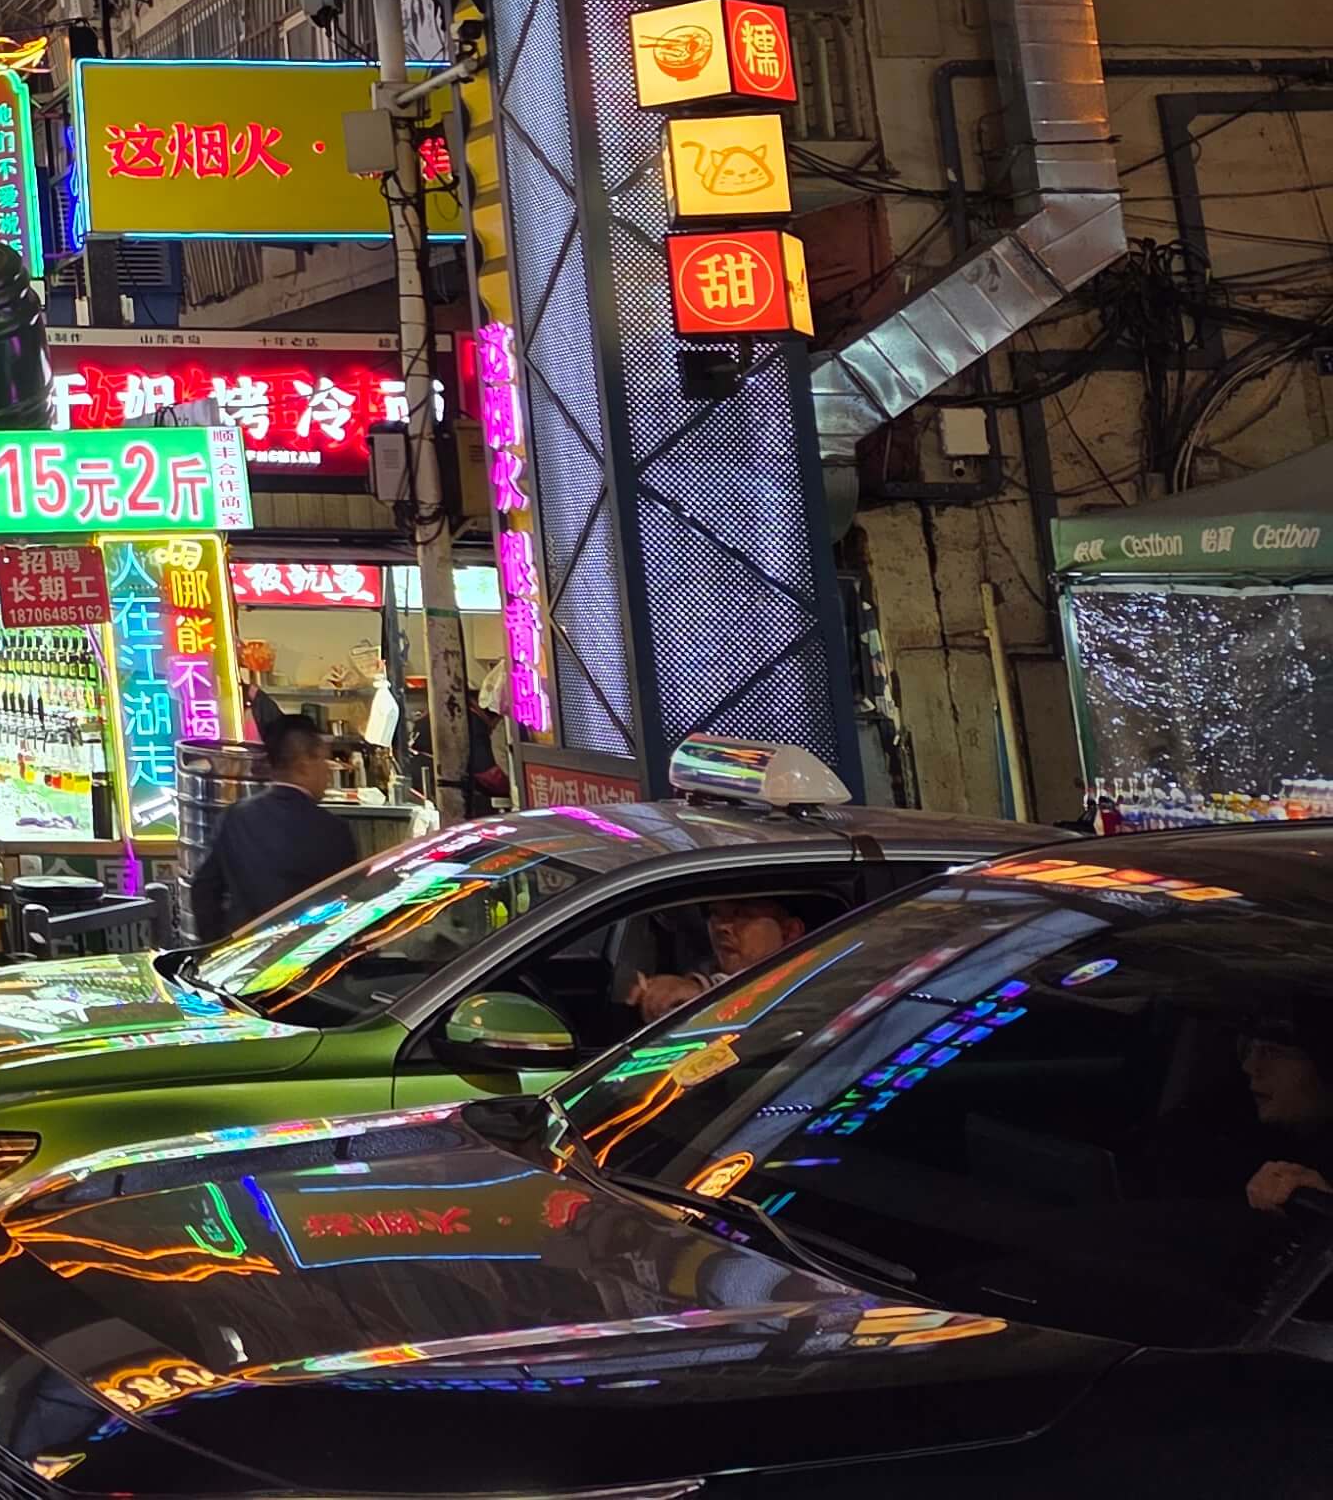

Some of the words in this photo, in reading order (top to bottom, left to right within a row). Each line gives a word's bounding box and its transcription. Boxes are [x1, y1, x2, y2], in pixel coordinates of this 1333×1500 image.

[739, 20, 780, 81] 糯
[696, 252, 759, 309] 甜
[18, 548, 82, 575] 招聘
[7, 576, 99, 602] 长期工
[232, 564, 375, 601] 板鱿鱼
[8, 604, 104, 624] 18706485162
[110, 543, 176, 788] 人在江湖走
